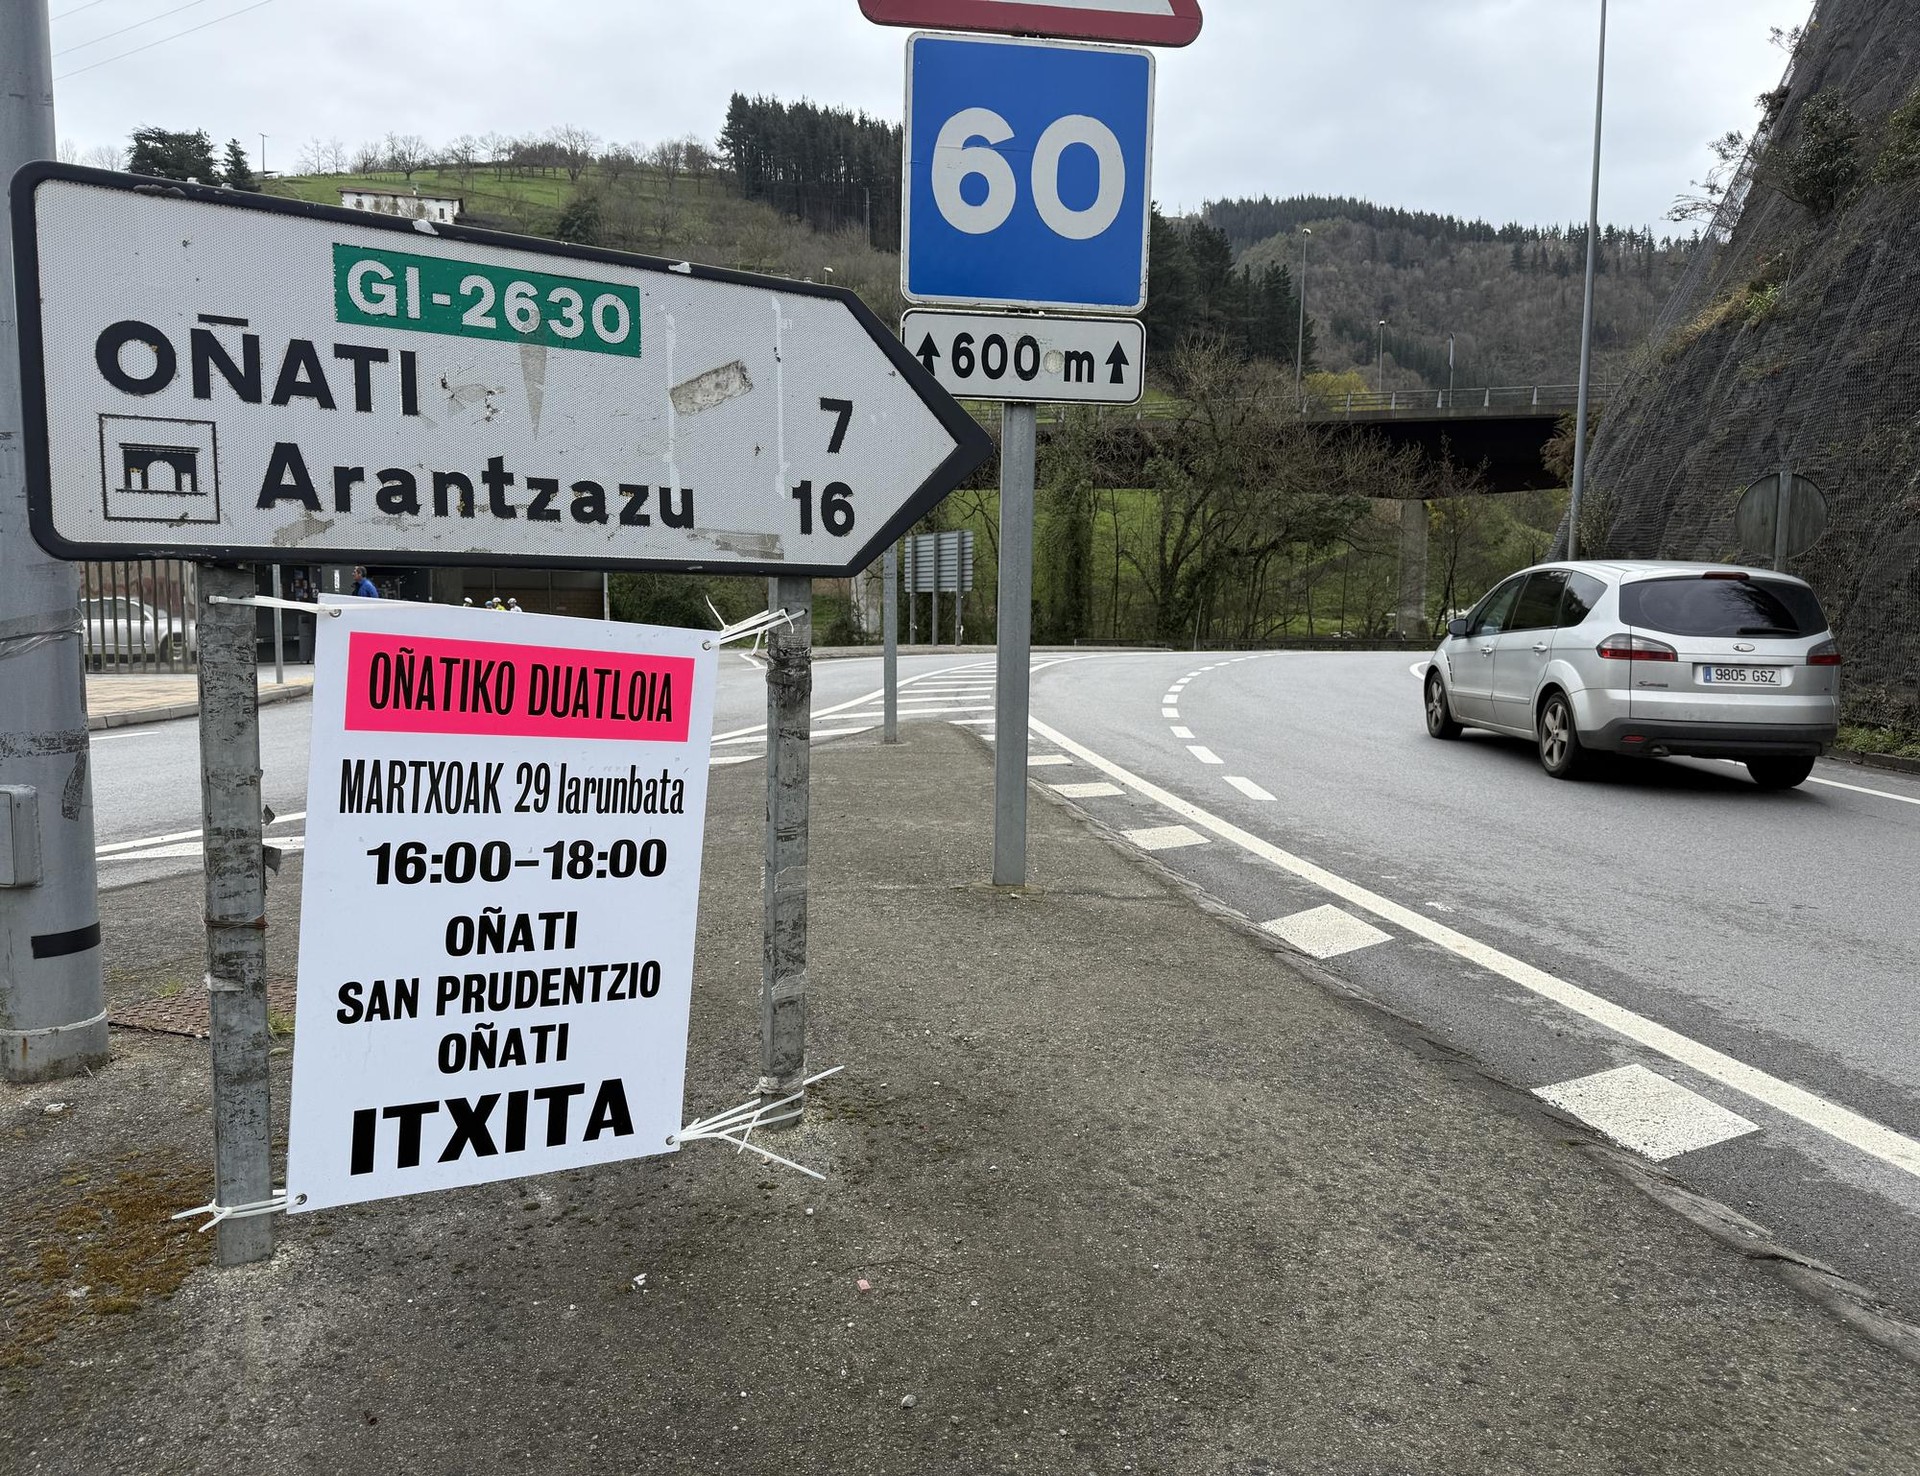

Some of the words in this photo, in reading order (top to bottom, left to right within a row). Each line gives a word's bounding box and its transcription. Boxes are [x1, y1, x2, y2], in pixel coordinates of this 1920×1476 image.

[932, 107, 1126, 240] 60
[346, 259, 631, 344] GI-2630
[96, 314, 420, 416] OÑATI
[820, 397, 853, 453] 7
[952, 332, 1040, 381] 600
[1063, 350, 1095, 383] m
[256, 442, 694, 529] Arantzazu
[792, 480, 855, 537] 16
[370, 648, 515, 715] OÑATIKO
[528, 664, 672, 722] DUATLOIA
[1714, 668, 1747, 681] 9805
[1752, 670, 1777, 683] GSZ
[340, 759, 504, 815] MARTXOAK
[515, 762, 550, 814] 29
[558, 763, 685, 815] larunbata
[446, 907, 577, 956] OÑATI
[337, 978, 419, 1024] SAN
[436, 961, 661, 1016] PRUDENTZIO
[438, 1022, 568, 1073] OÑATI
[351, 1079, 635, 1175] ITXITA
